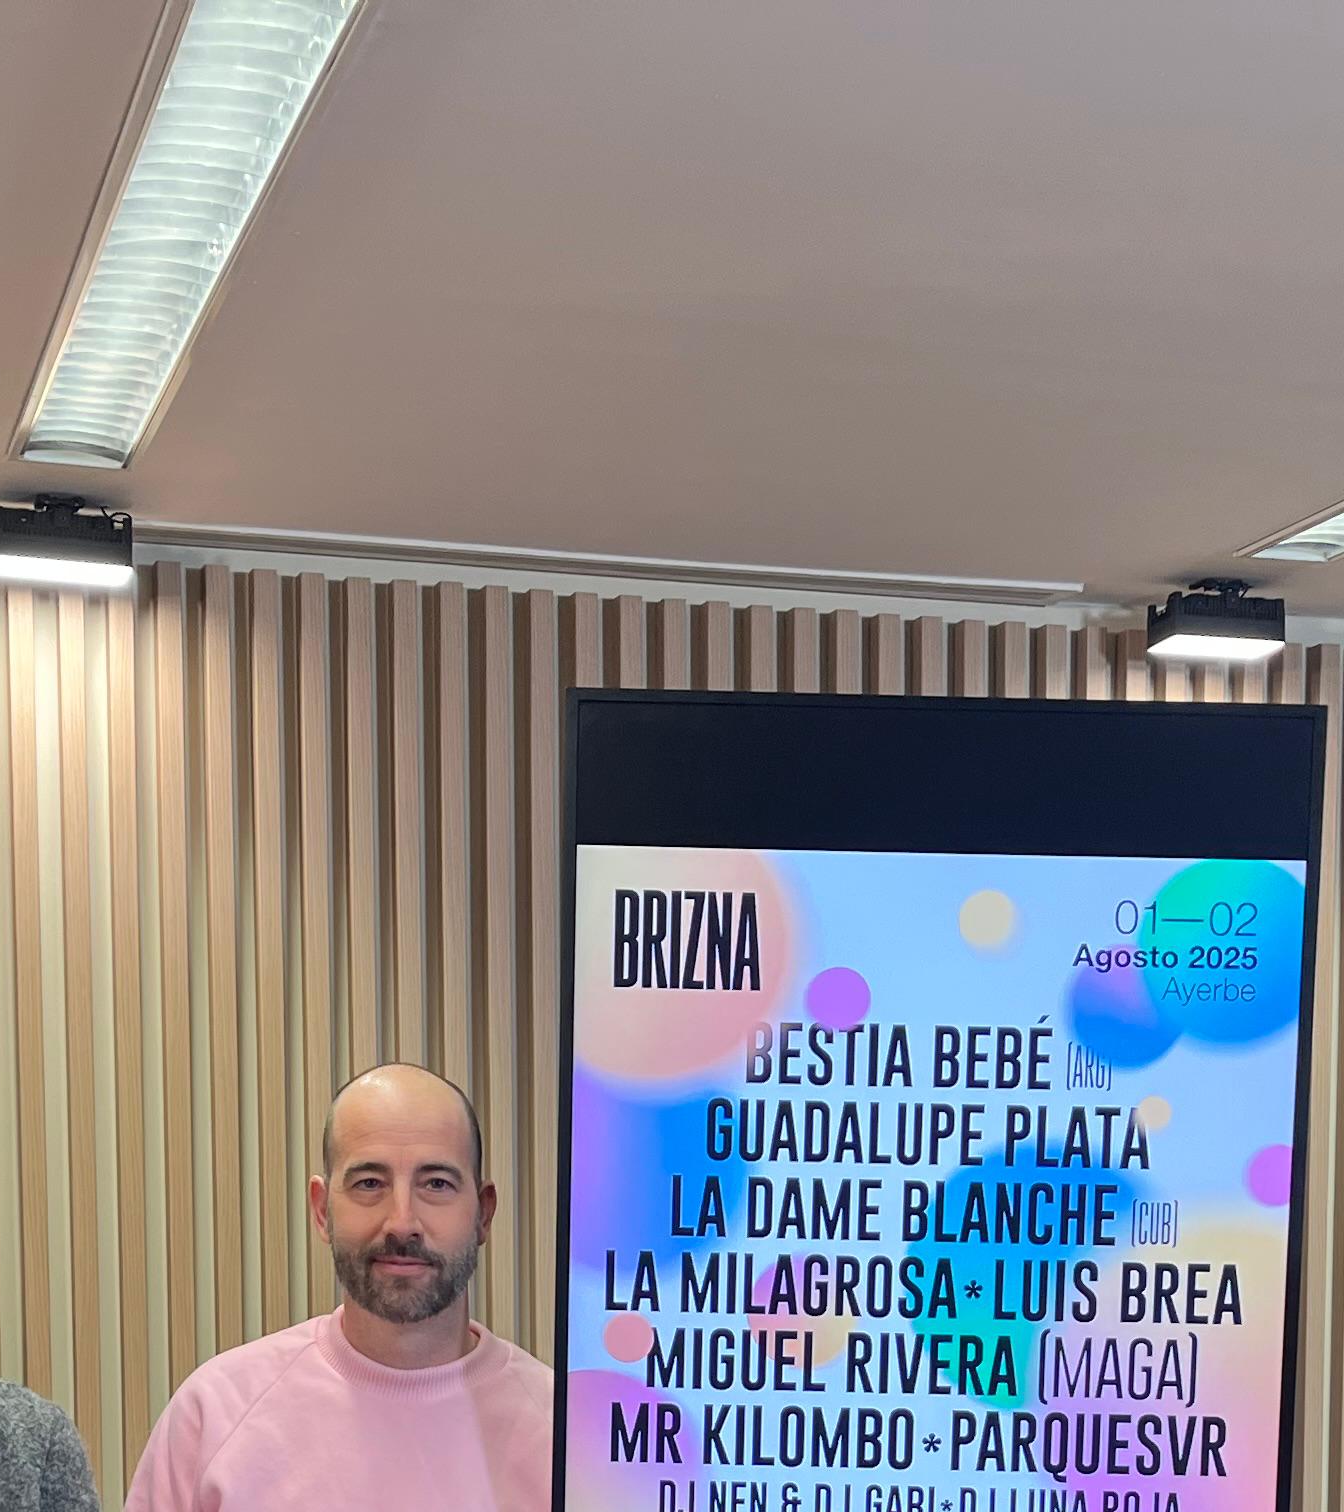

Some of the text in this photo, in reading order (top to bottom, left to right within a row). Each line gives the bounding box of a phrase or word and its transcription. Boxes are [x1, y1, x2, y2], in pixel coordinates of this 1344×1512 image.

[613, 889, 760, 991] BRIZNA
[1072, 944, 1258, 972] Agosto 2025
[1162, 976, 1257, 1004] Ayerbe
[745, 1021, 913, 1088] BESTIA
[932, 1016, 1053, 1090] BEBÉ
[705, 1098, 1150, 1170] GUADALUPE PLATA
[670, 1175, 727, 1237] LA
[747, 1177, 881, 1241] DAME
[902, 1181, 1118, 1247] BLANCHE
[604, 1250, 1242, 1324] LA MILAGROSA LUIS BREA
[645, 1327, 826, 1392] MIGUEL
[846, 1332, 1018, 1396] RIVERA
[610, 1402, 1227, 1482] MR KILOMBO PARQUESVR
